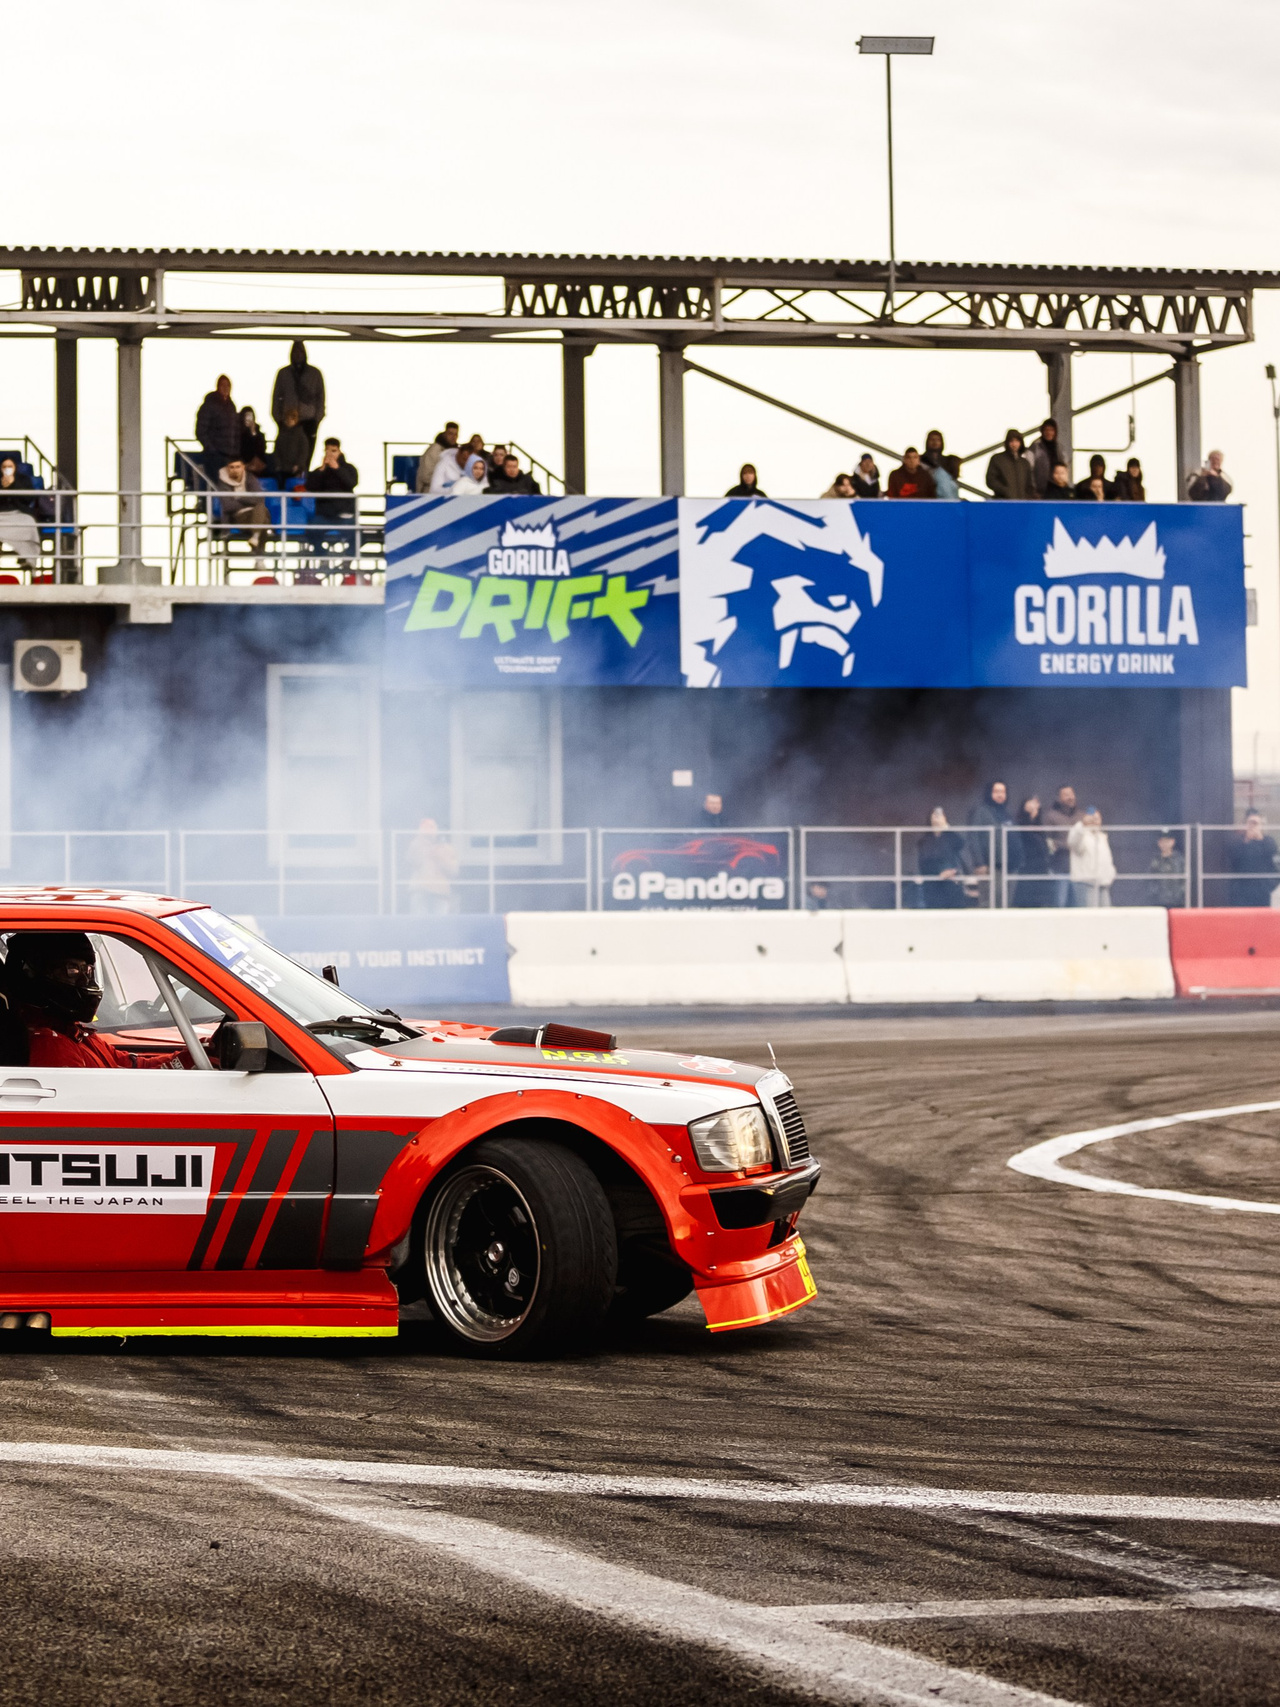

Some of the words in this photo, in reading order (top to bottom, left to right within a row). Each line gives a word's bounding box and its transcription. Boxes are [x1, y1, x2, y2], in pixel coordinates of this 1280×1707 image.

[488, 549, 570, 576] GORILLA
[403, 570, 650, 648] DRIFT
[1014, 584, 1199, 646] GORILLA
[1040, 653, 1114, 674] ENERGY
[1117, 653, 1175, 674] DRINK
[638, 871, 785, 900] Pandora
[357, 950, 402, 968] YOUR
[407, 948, 485, 967] INSTINCT
[46, 1196, 85, 1206] THE
[94, 1197, 163, 1206] JAPAN
